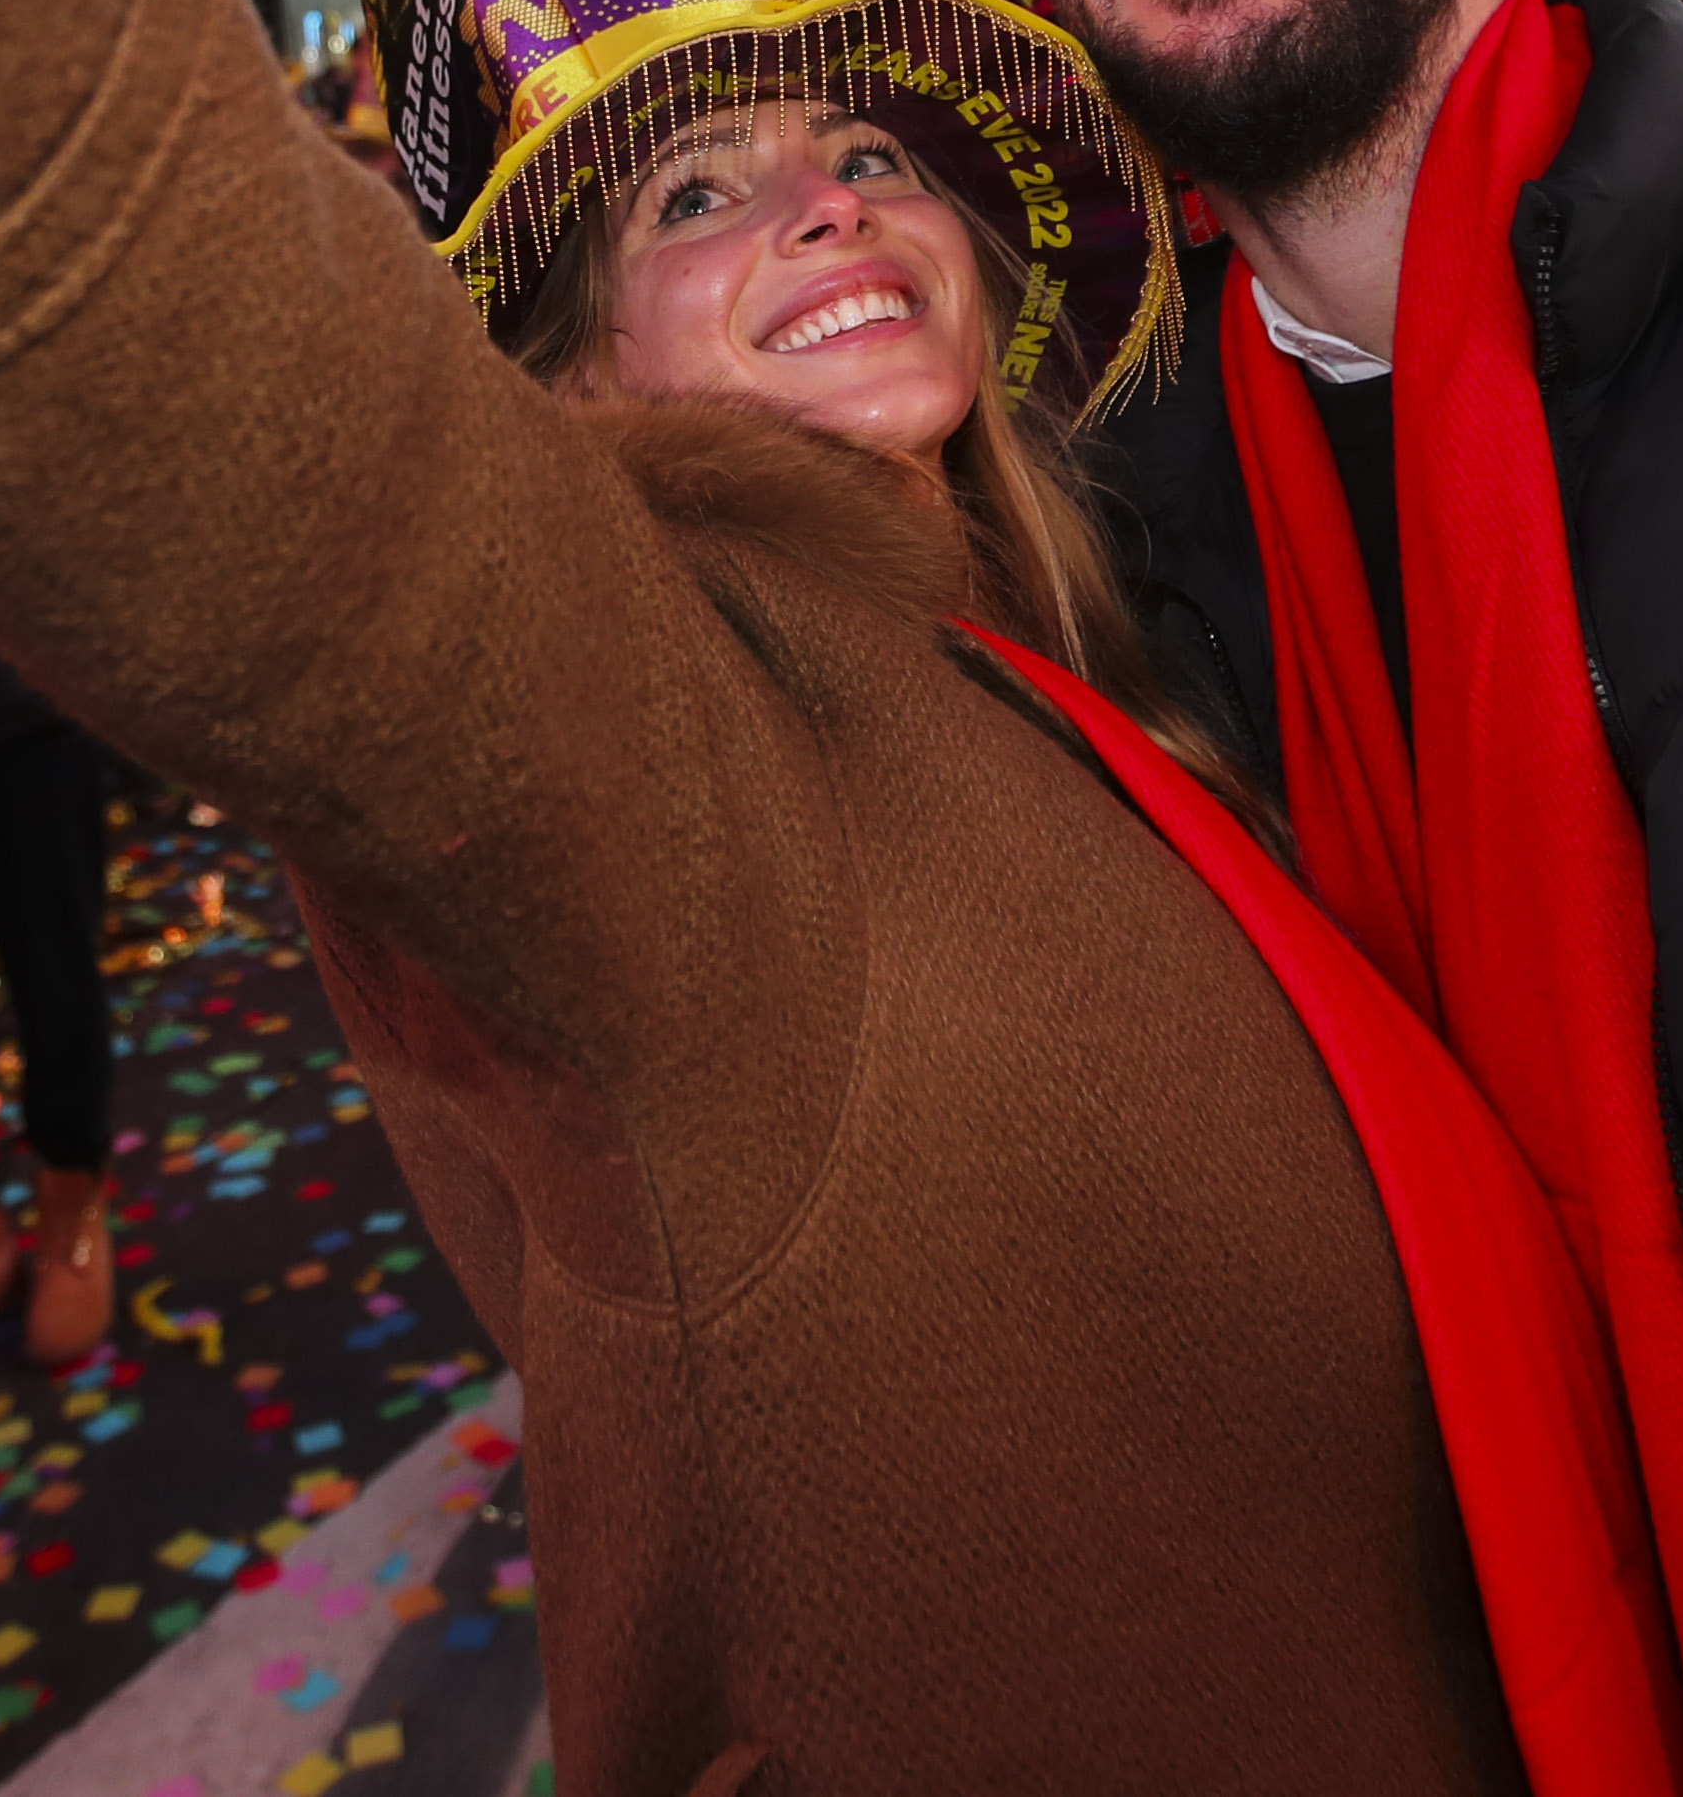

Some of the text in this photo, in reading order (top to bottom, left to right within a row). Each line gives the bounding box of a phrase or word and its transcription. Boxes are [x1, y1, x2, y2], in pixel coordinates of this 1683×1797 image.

[825, 43, 973, 102] YEARS
[955, 89, 1042, 164] EVE
[1009, 163, 1073, 249] 2022
